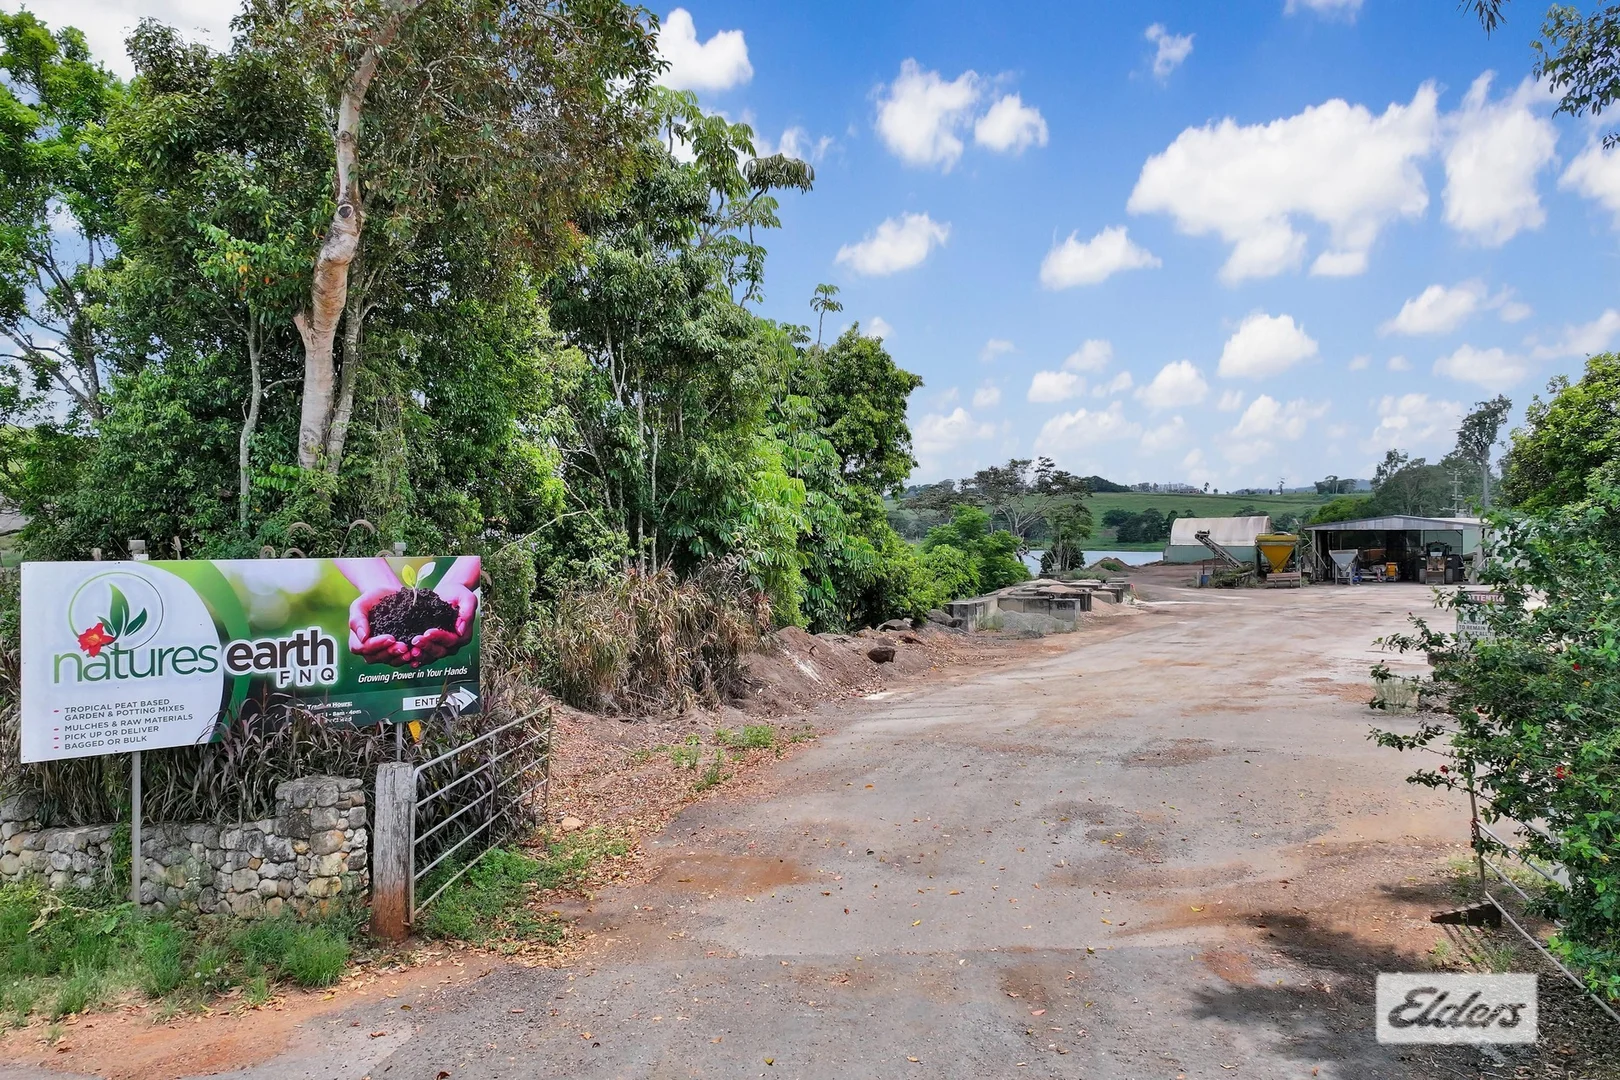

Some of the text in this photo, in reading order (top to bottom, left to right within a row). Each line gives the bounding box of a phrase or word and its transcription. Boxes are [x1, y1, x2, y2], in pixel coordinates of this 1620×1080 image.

[1466, 594, 1505, 602] ATTENTIO
[54, 629, 334, 684] natures earth
[358, 666, 468, 683] Growing Power in Your Hands
[64, 699, 170, 714] TROPICAL PEAT BASED
[414, 697, 443, 707] ENTE
[64, 704, 185, 721] GARDEN & POTTING MIXES
[64, 721, 109, 732] MULCHES
[120, 718, 142, 727] RAW
[144, 714, 194, 724] MATERIALS
[64, 732, 87, 741] PICK
[89, 731, 102, 739] UP
[121, 725, 160, 735] DELIVER
[64, 735, 148, 750] BAGGED OR BULK
